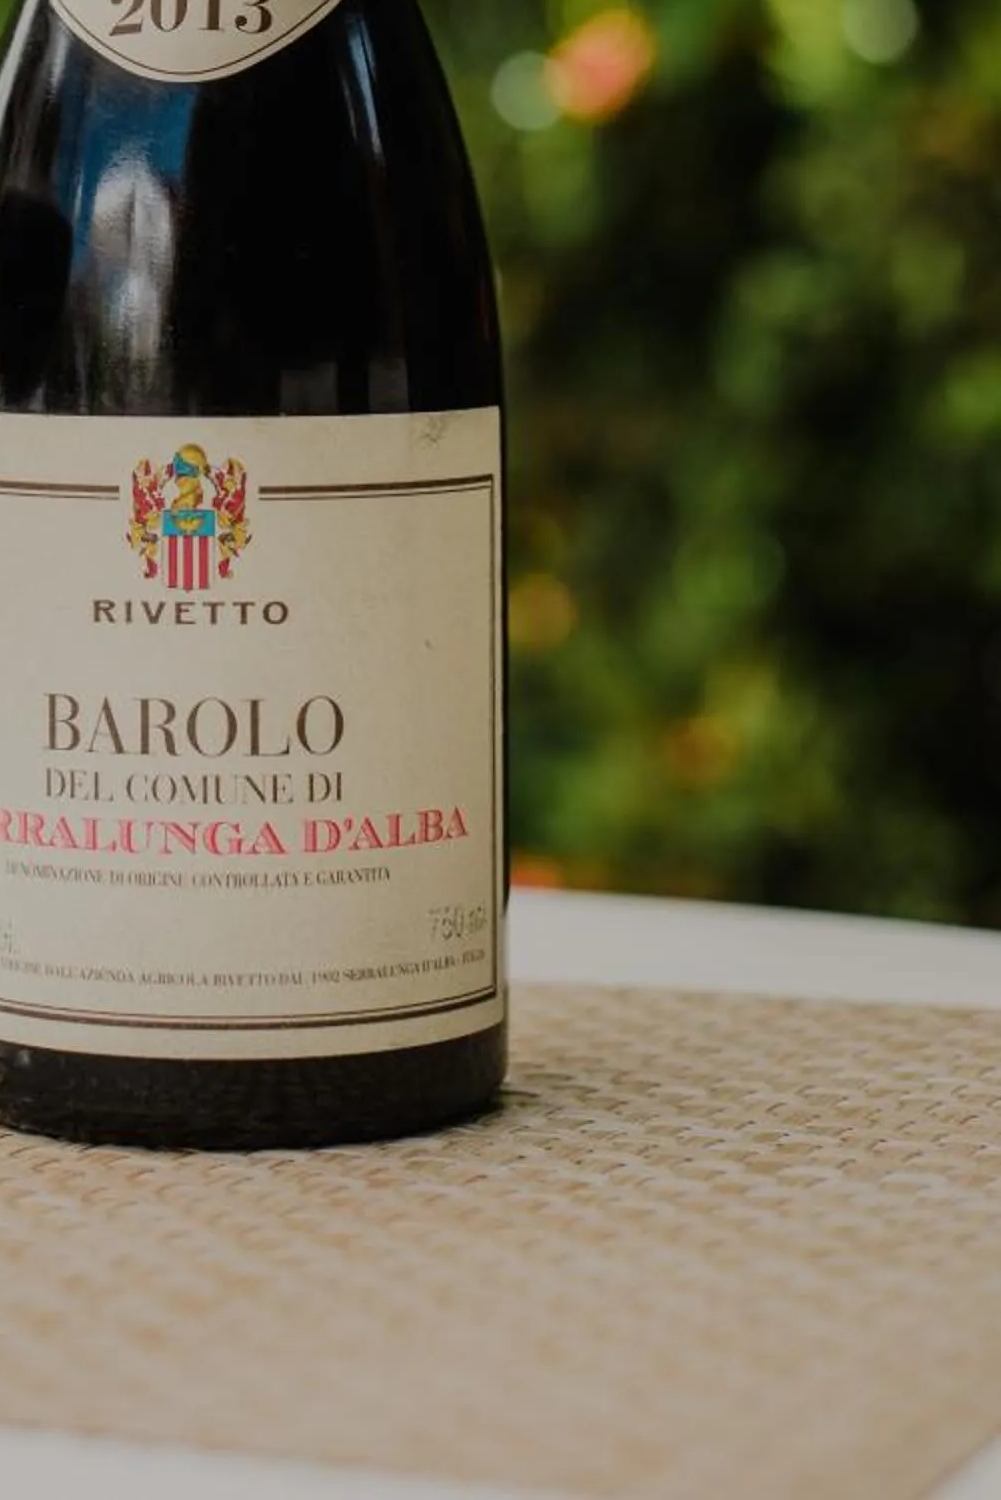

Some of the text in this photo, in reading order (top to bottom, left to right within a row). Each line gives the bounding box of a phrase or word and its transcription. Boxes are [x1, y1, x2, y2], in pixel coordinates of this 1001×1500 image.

[92, 599, 289, 626] RIVETTO
[43, 693, 345, 759] BAROLO
[45, 767, 342, 805] DEL COMUNE DI
[302, 805, 469, 854] D'ALBA
